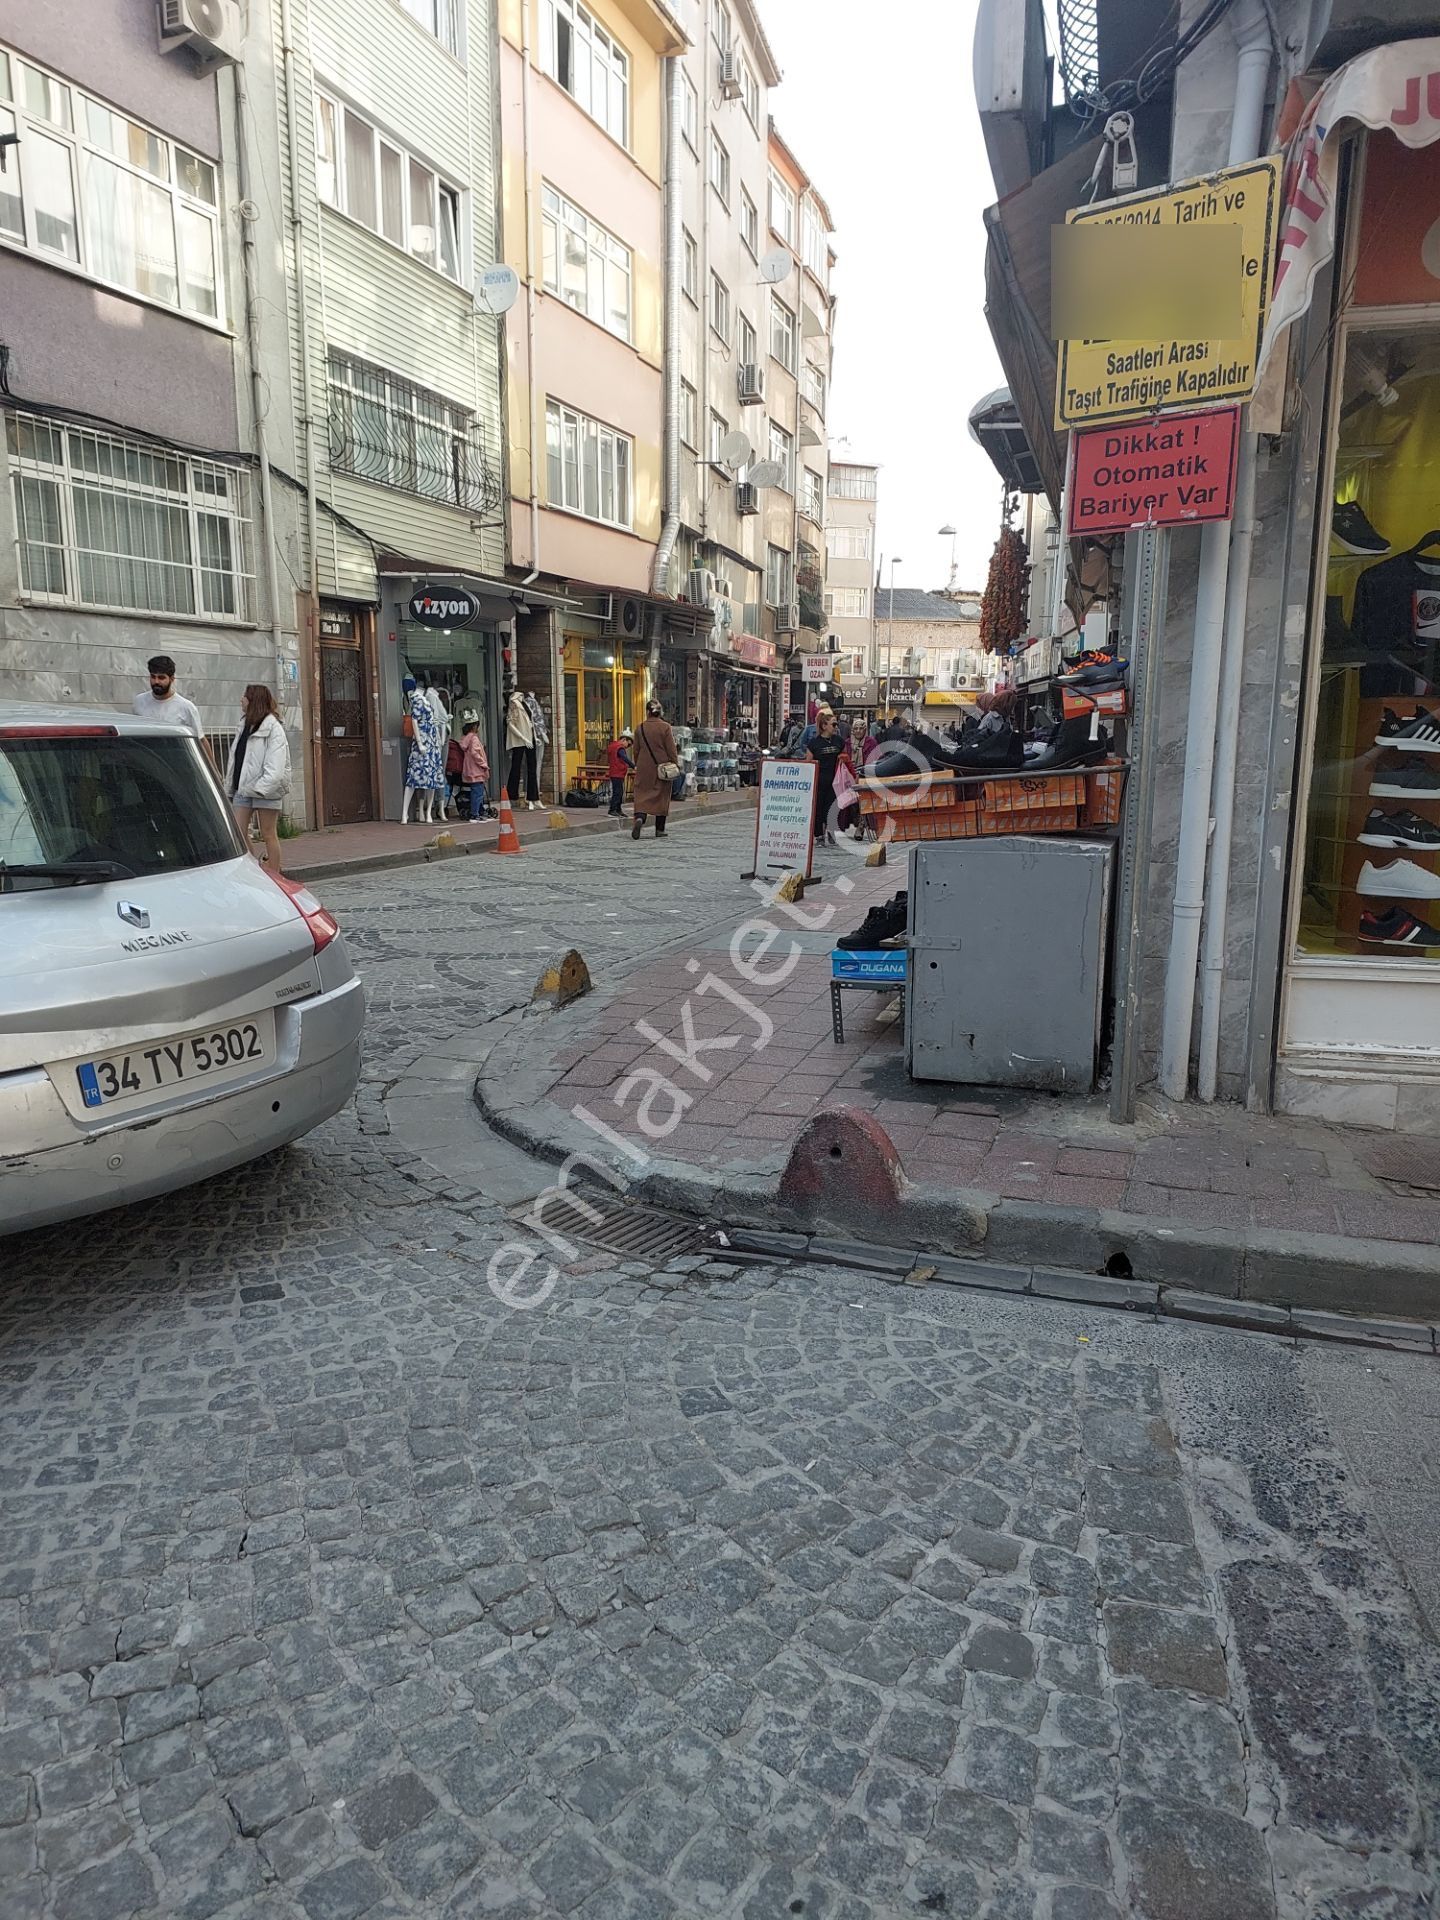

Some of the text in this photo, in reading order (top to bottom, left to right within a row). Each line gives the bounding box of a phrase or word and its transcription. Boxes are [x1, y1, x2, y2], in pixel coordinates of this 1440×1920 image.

[1174, 192, 1217, 225] Tarih
[1224, 191, 1245, 212] ve
[1106, 344, 1164, 374] Saatleri
[1067, 362, 1250, 414] Taşıt Trafiğine Kapalıdır
[1105, 426, 1200, 458] Dikkat !
[1093, 455, 1208, 487] Otomatik
[1080, 485, 1218, 517] Bariyer Var
[413, 598, 471, 619] vizyon
[807, 658, 828, 667] BERBER
[810, 670, 825, 678] OZAN
[776, 766, 800, 775] ATTAR
[121, 930, 193, 953] MEGANE
[860, 963, 904, 973] DUGANA
[98, 1025, 262, 1097] 34 TY 5302
[85, 1087, 98, 1100] TR
